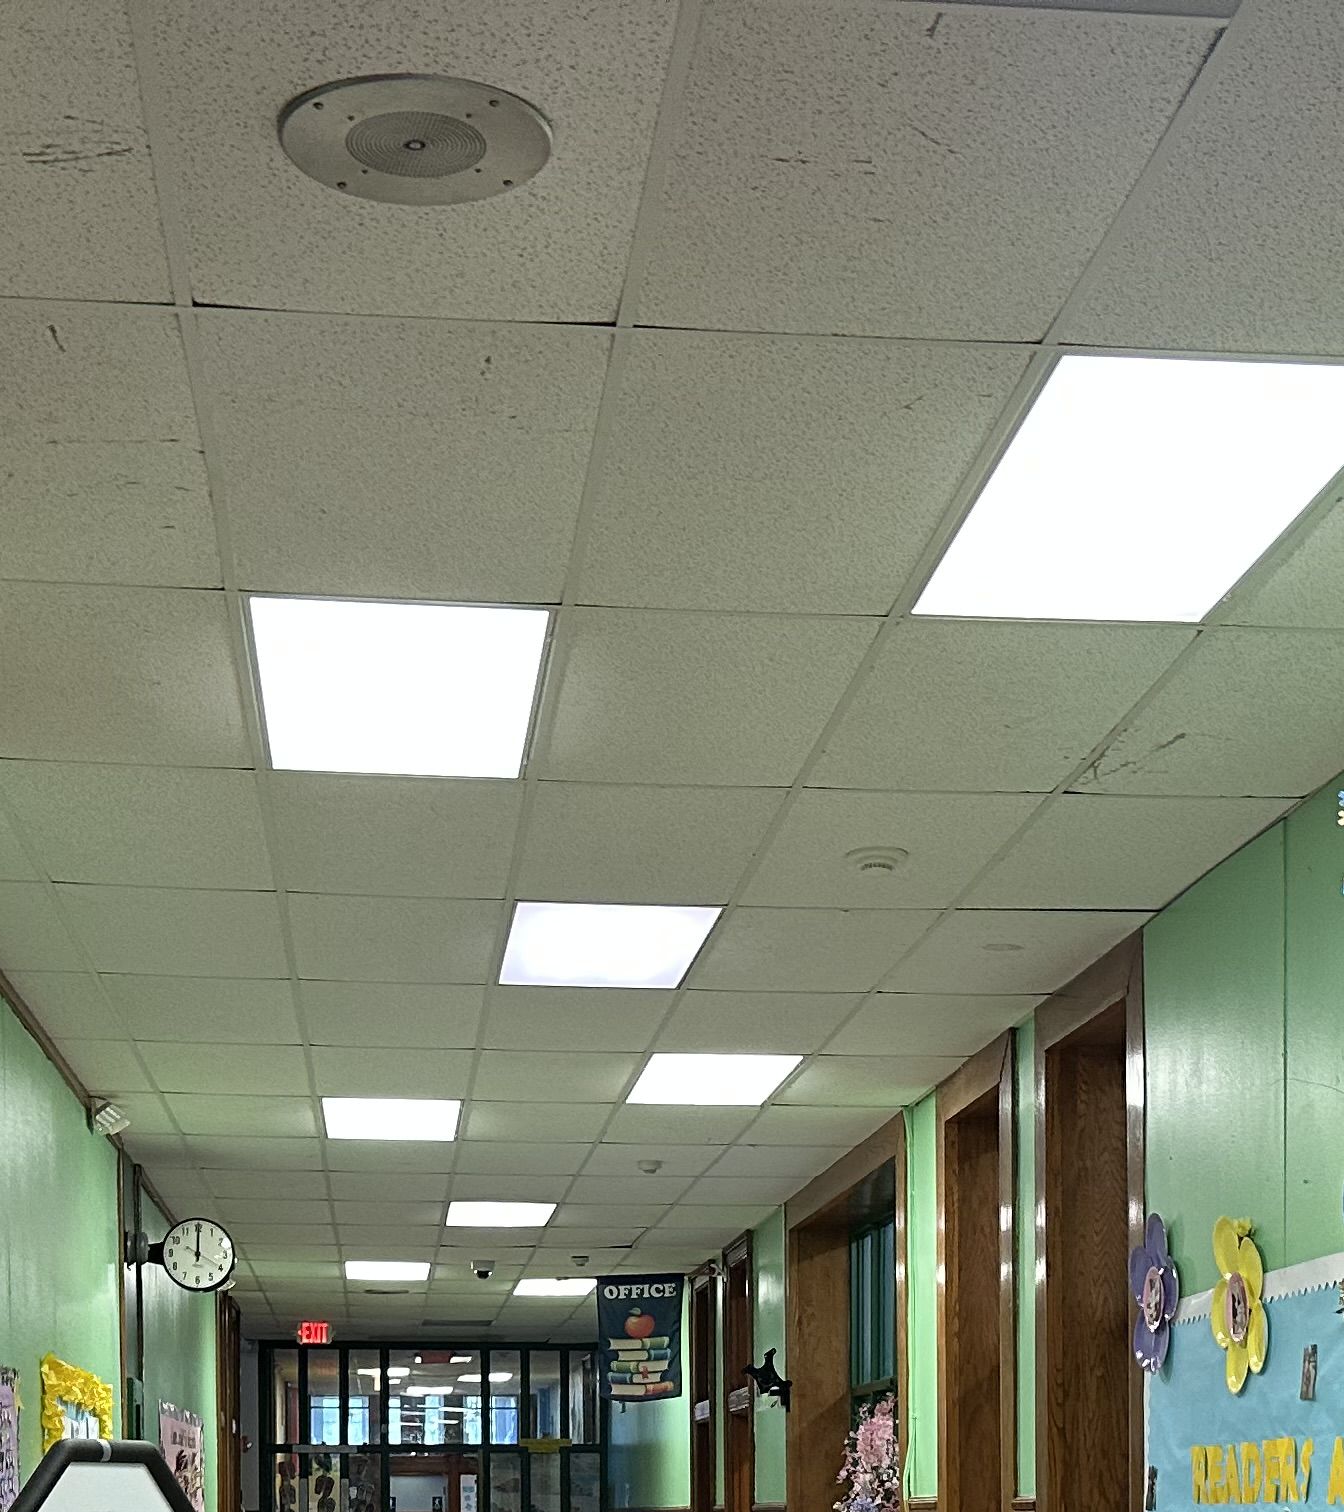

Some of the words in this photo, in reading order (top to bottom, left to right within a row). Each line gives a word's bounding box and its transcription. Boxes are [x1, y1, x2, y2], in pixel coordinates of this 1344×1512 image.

[604, 1283, 677, 1299] OFFICE
[302, 1322, 329, 1343] EXIT
[1191, 1437, 1314, 1504] READERS
